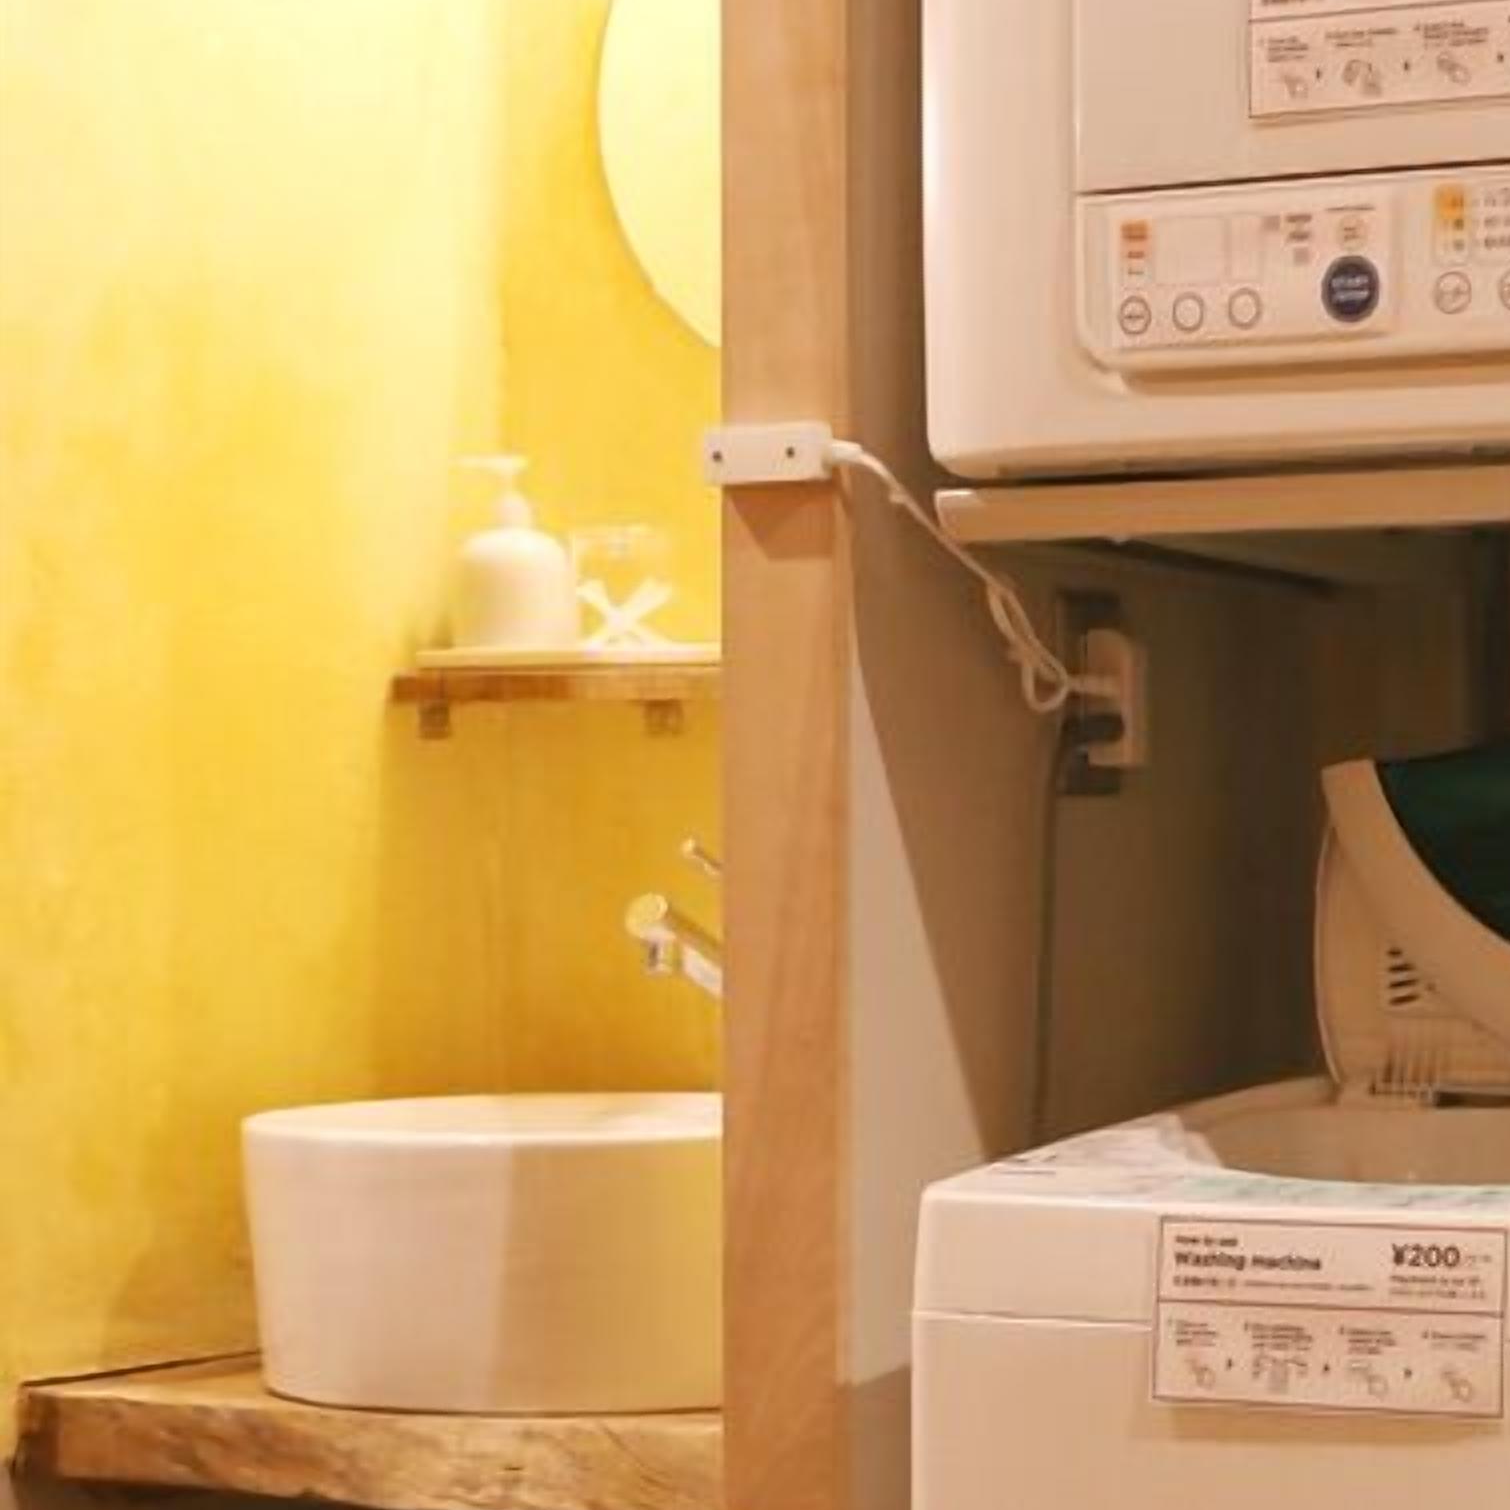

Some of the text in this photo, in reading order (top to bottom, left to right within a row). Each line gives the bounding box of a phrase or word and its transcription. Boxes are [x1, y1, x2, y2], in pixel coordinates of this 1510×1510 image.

[1175, 1251, 1322, 1271] Washing machine
[1391, 1243, 1460, 1267] ¥200
